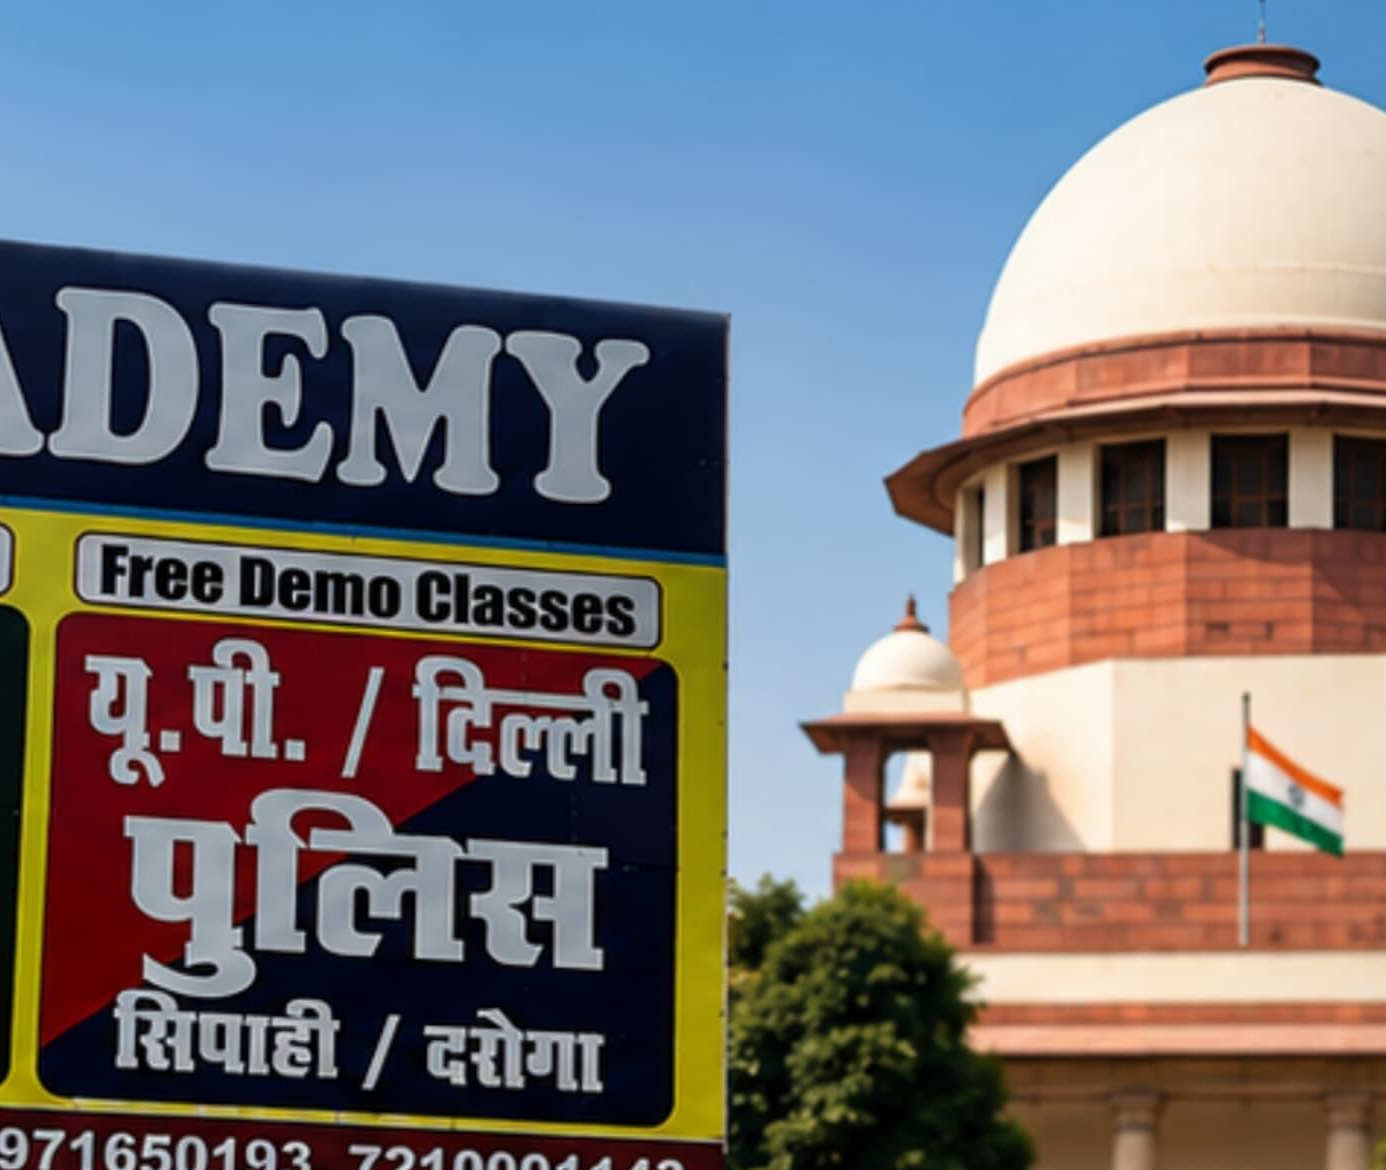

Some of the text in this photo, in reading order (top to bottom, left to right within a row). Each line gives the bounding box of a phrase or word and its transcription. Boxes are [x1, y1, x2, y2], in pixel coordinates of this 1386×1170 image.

[99, 543, 637, 637] Free Demo Classes
[412, 654, 649, 786] दिल्ली
[123, 788, 609, 997] पुलिस
[114, 988, 340, 1080] सिपाही
[424, 1008, 605, 1093] दरोगा
